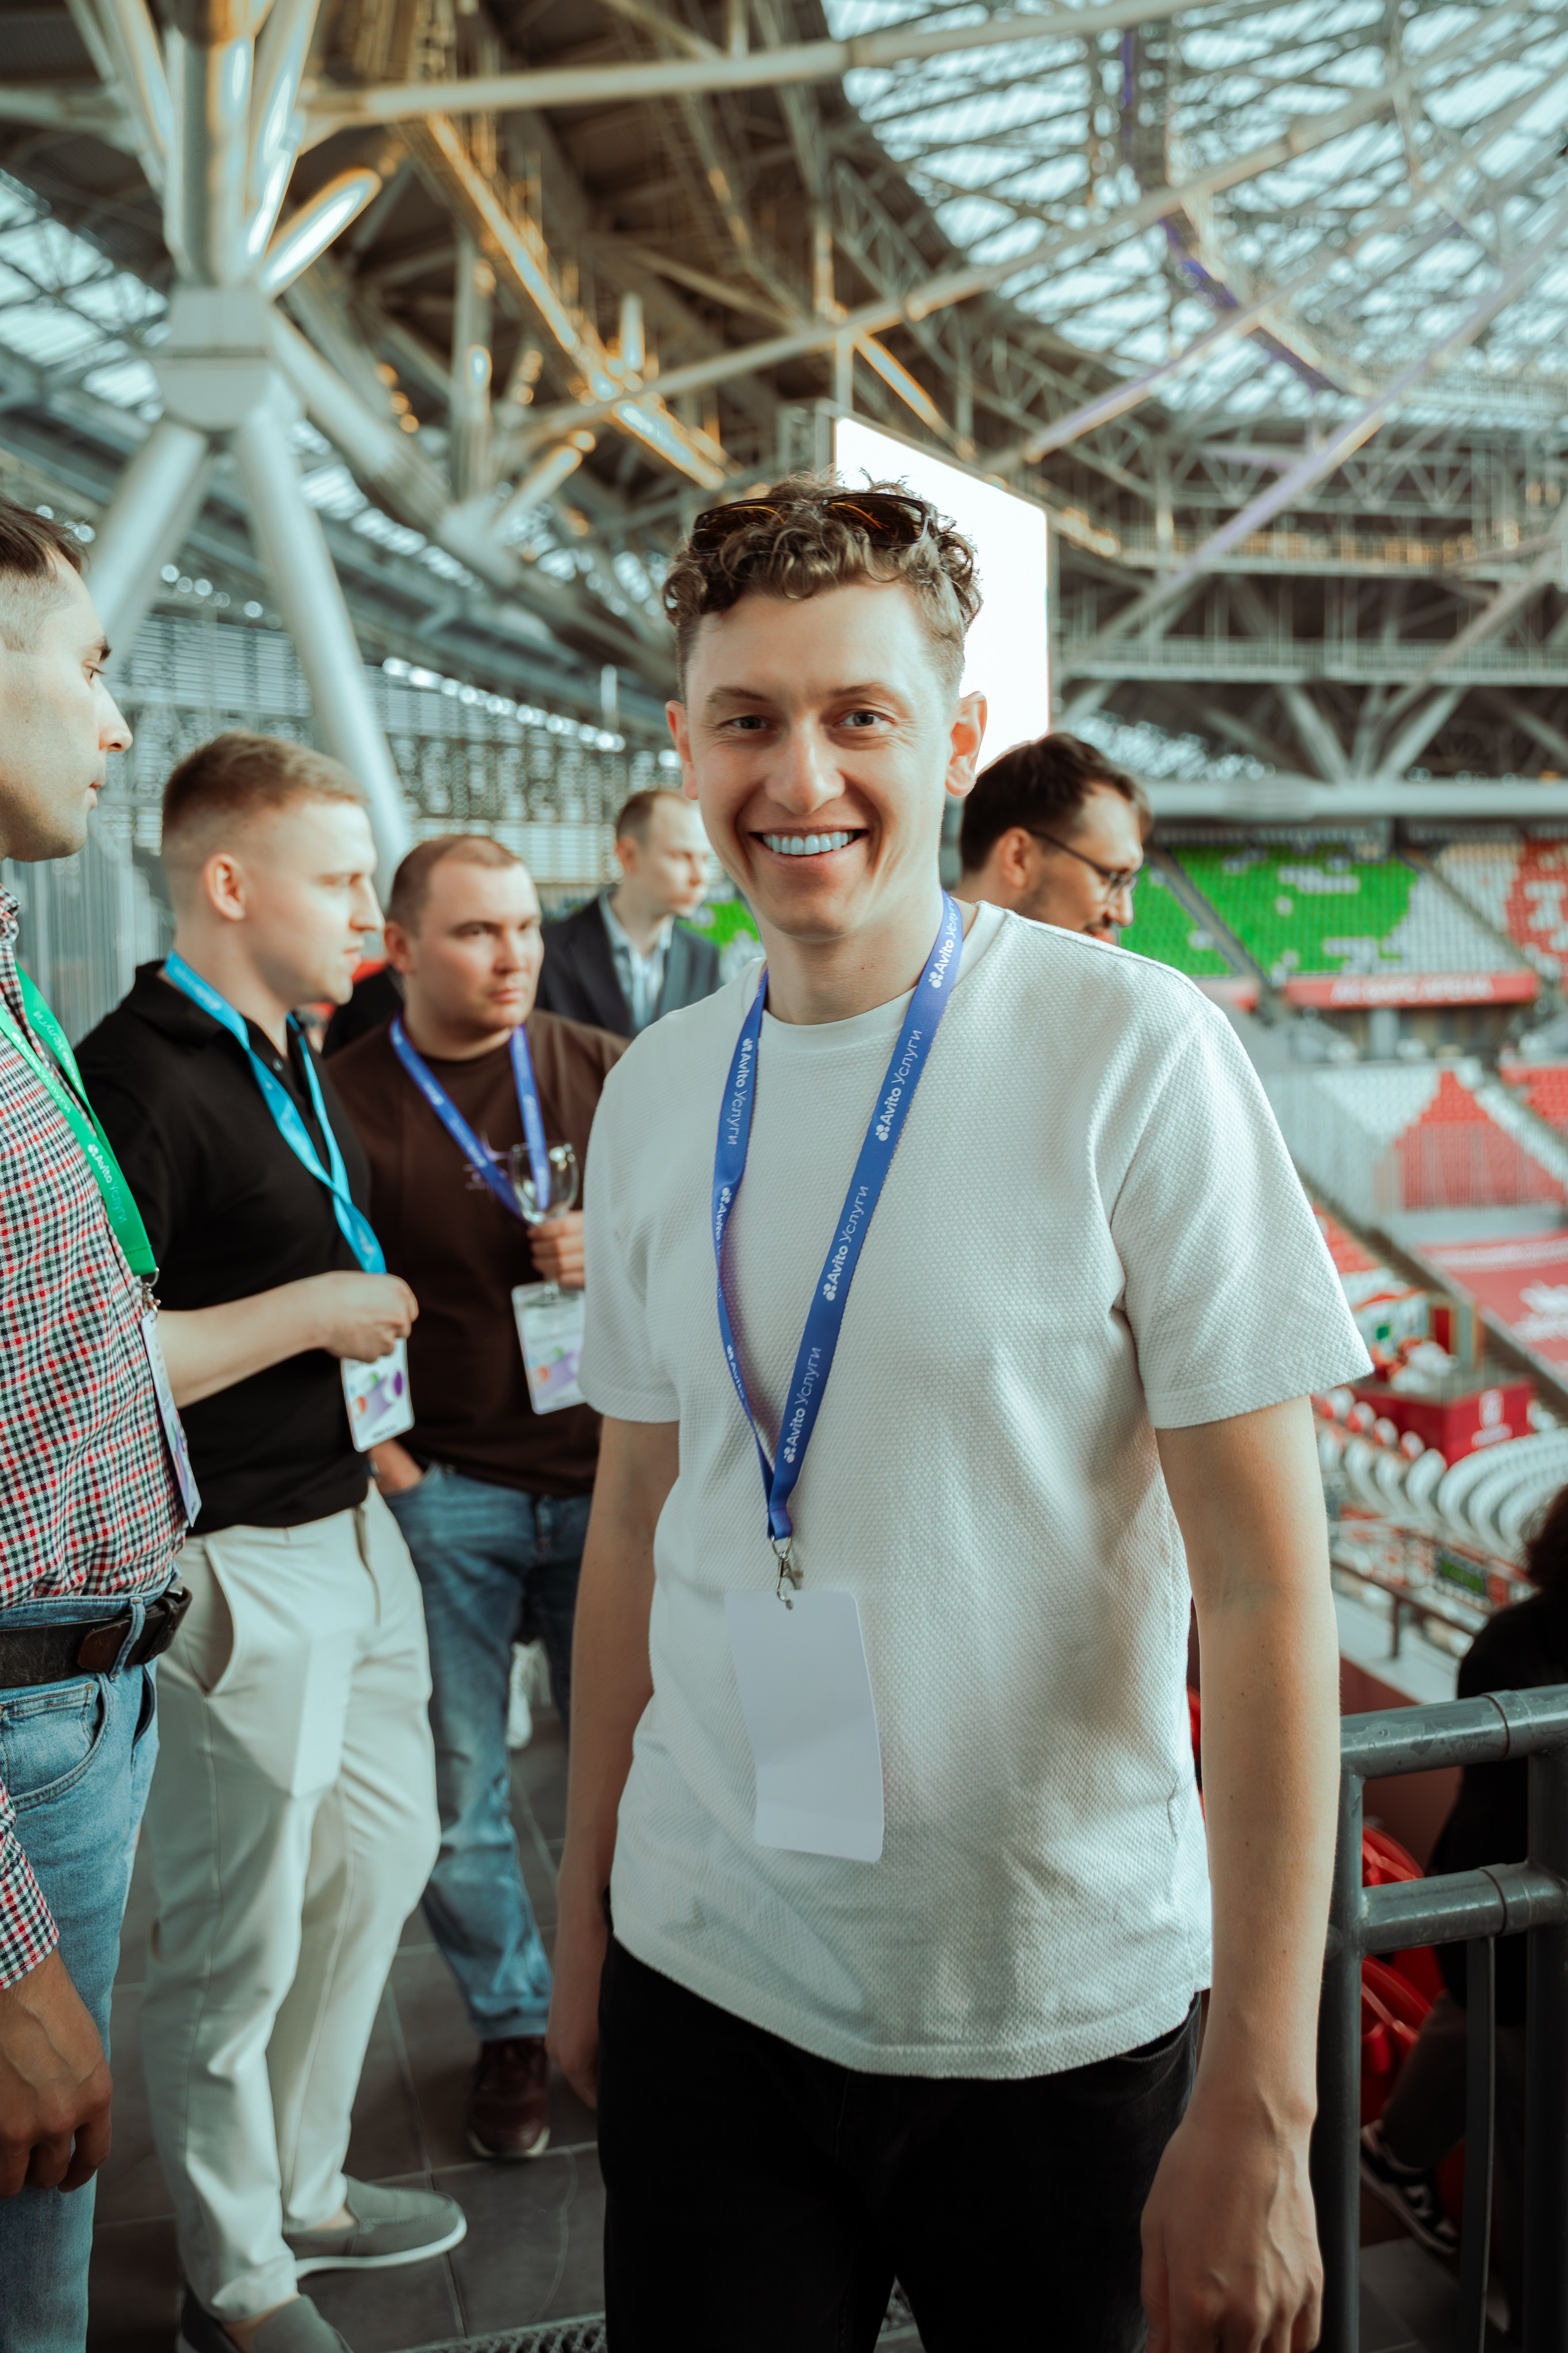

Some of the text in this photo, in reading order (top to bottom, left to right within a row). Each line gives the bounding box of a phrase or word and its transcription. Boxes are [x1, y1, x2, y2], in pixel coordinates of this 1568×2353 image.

[933, 939, 954, 975] Avito
[726, 1053, 752, 1145] Avito Услуги
[880, 1030, 922, 1126] Avito Услуги
[94, 1154, 127, 1223] Avito Услуги
[827, 1185, 869, 1285] Avito Услуги
[786, 1347, 822, 1448] Avito Услуги
